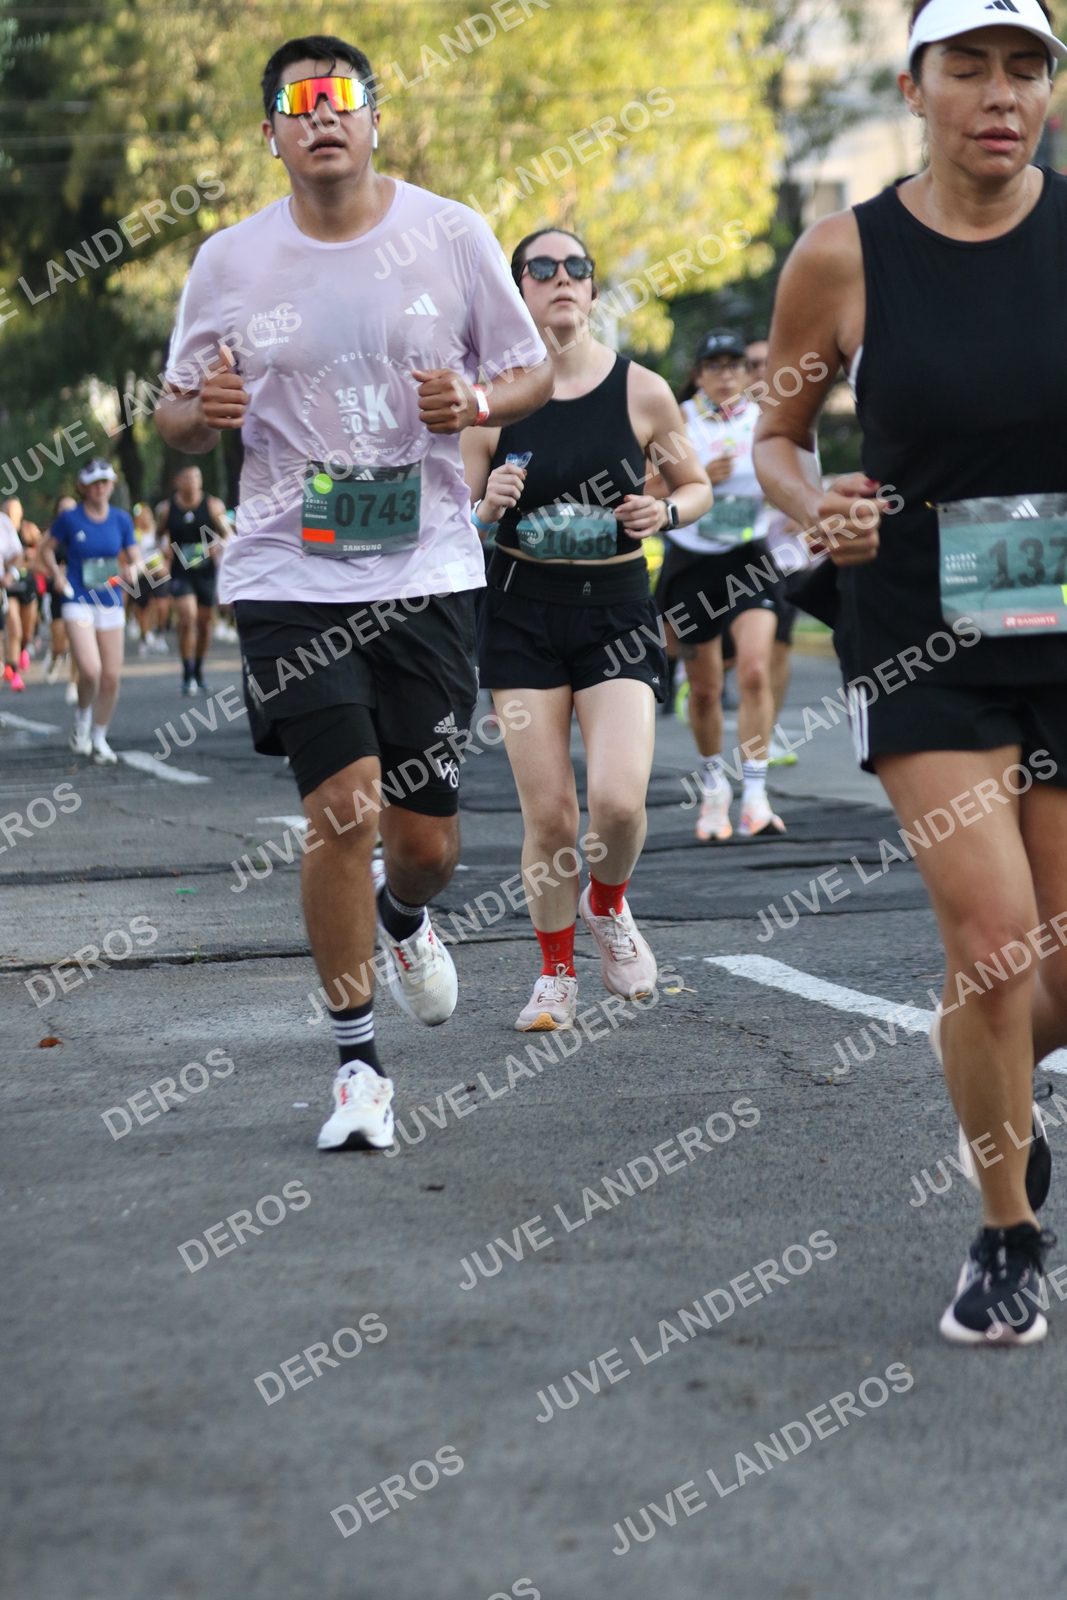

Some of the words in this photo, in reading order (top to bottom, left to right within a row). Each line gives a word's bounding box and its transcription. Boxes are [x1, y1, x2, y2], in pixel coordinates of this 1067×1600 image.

[335, 386, 359, 407] 15
[363, 383, 399, 432] K
[335, 489, 417, 528] 0743
[343, 543, 382, 552] SAMSUNG
